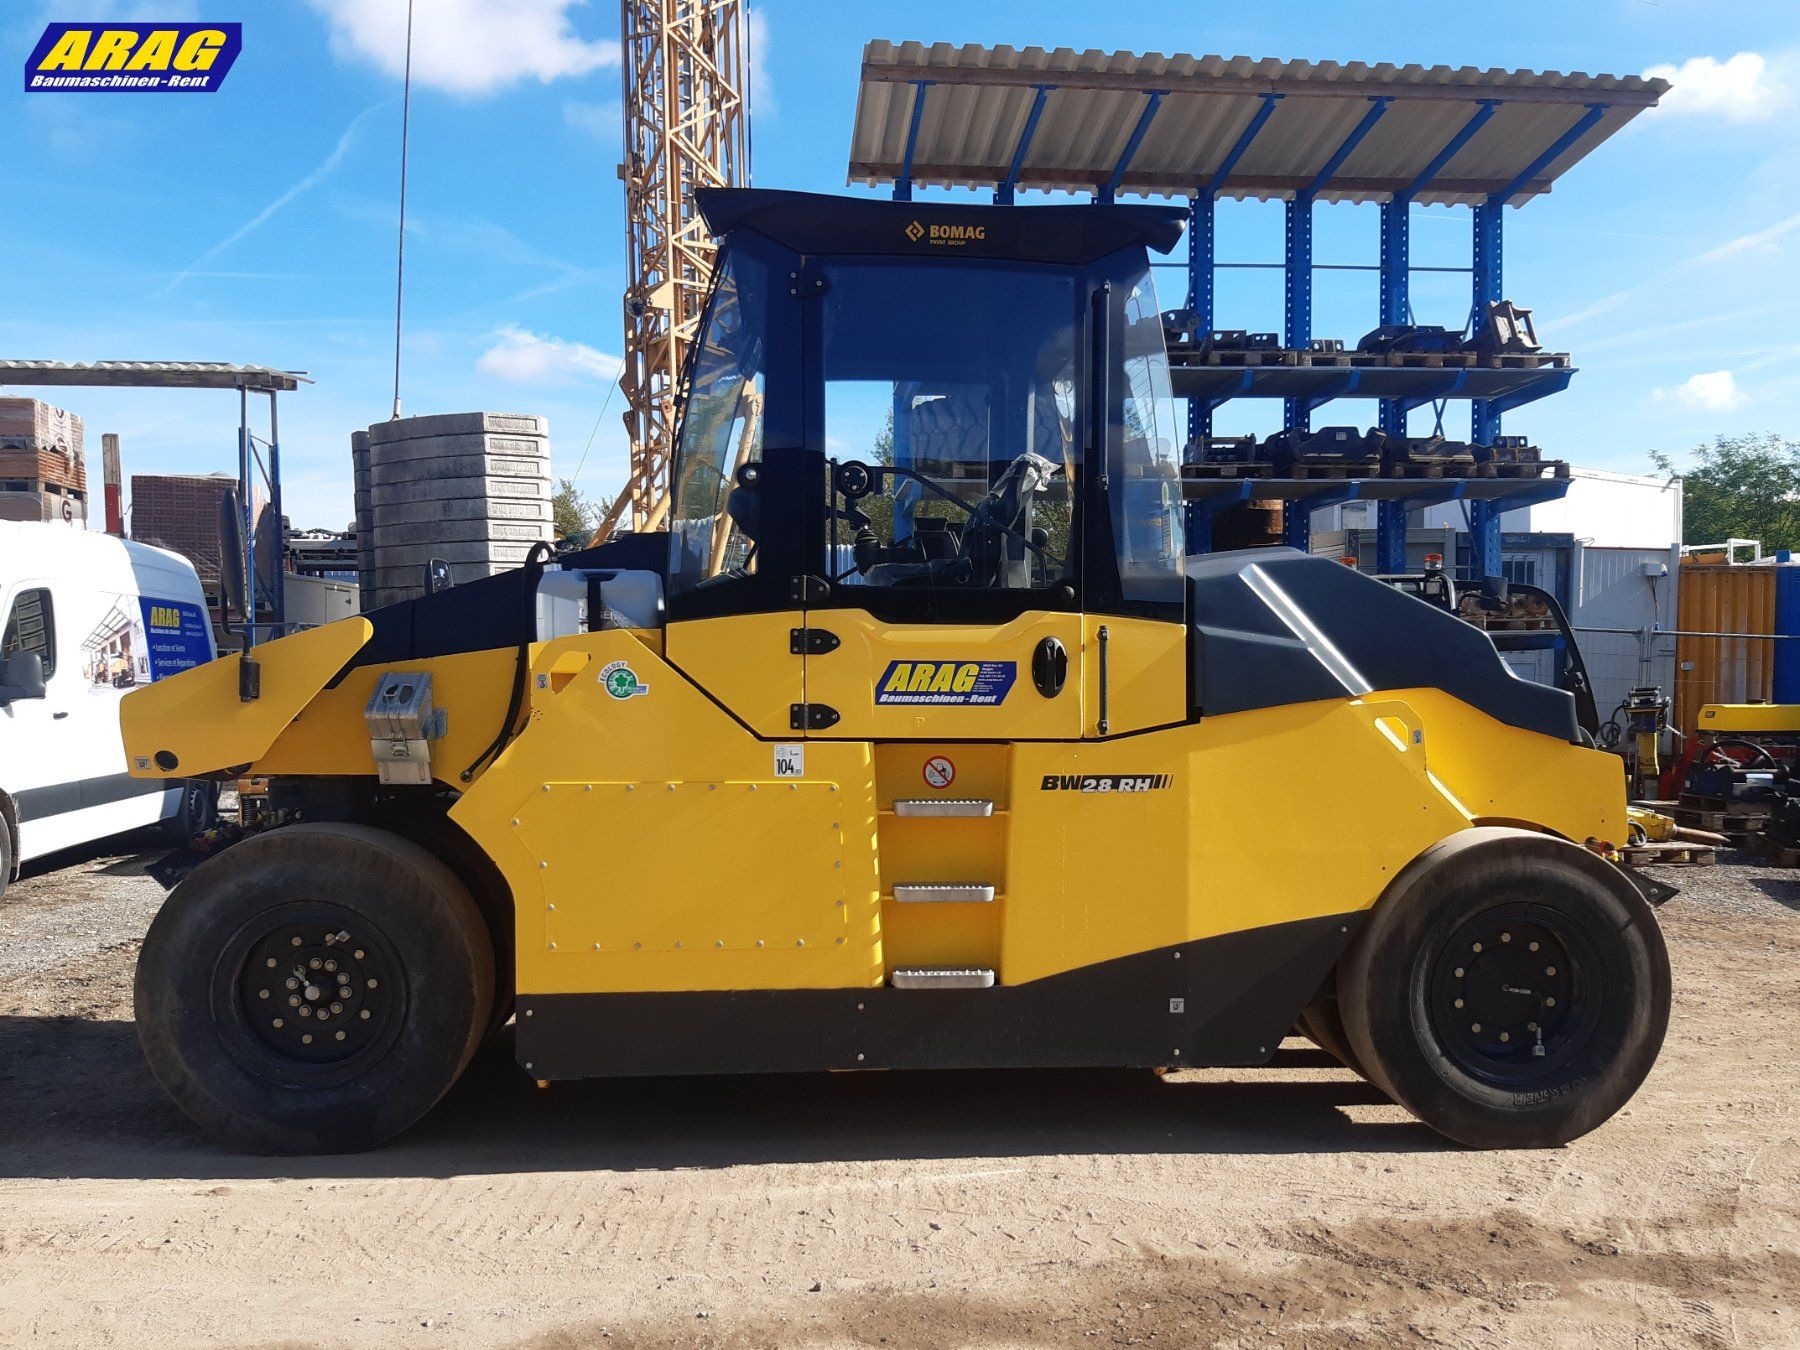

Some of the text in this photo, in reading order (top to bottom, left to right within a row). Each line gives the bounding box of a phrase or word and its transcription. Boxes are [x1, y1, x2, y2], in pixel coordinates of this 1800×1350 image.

[930, 225, 985, 240] BOMAG
[151, 607, 180, 627] ARAG
[600, 662, 626, 681] ECOLOGY
[884, 663, 979, 692] ARAG
[777, 759, 794, 774] 104
[1117, 778, 1150, 793] RH
